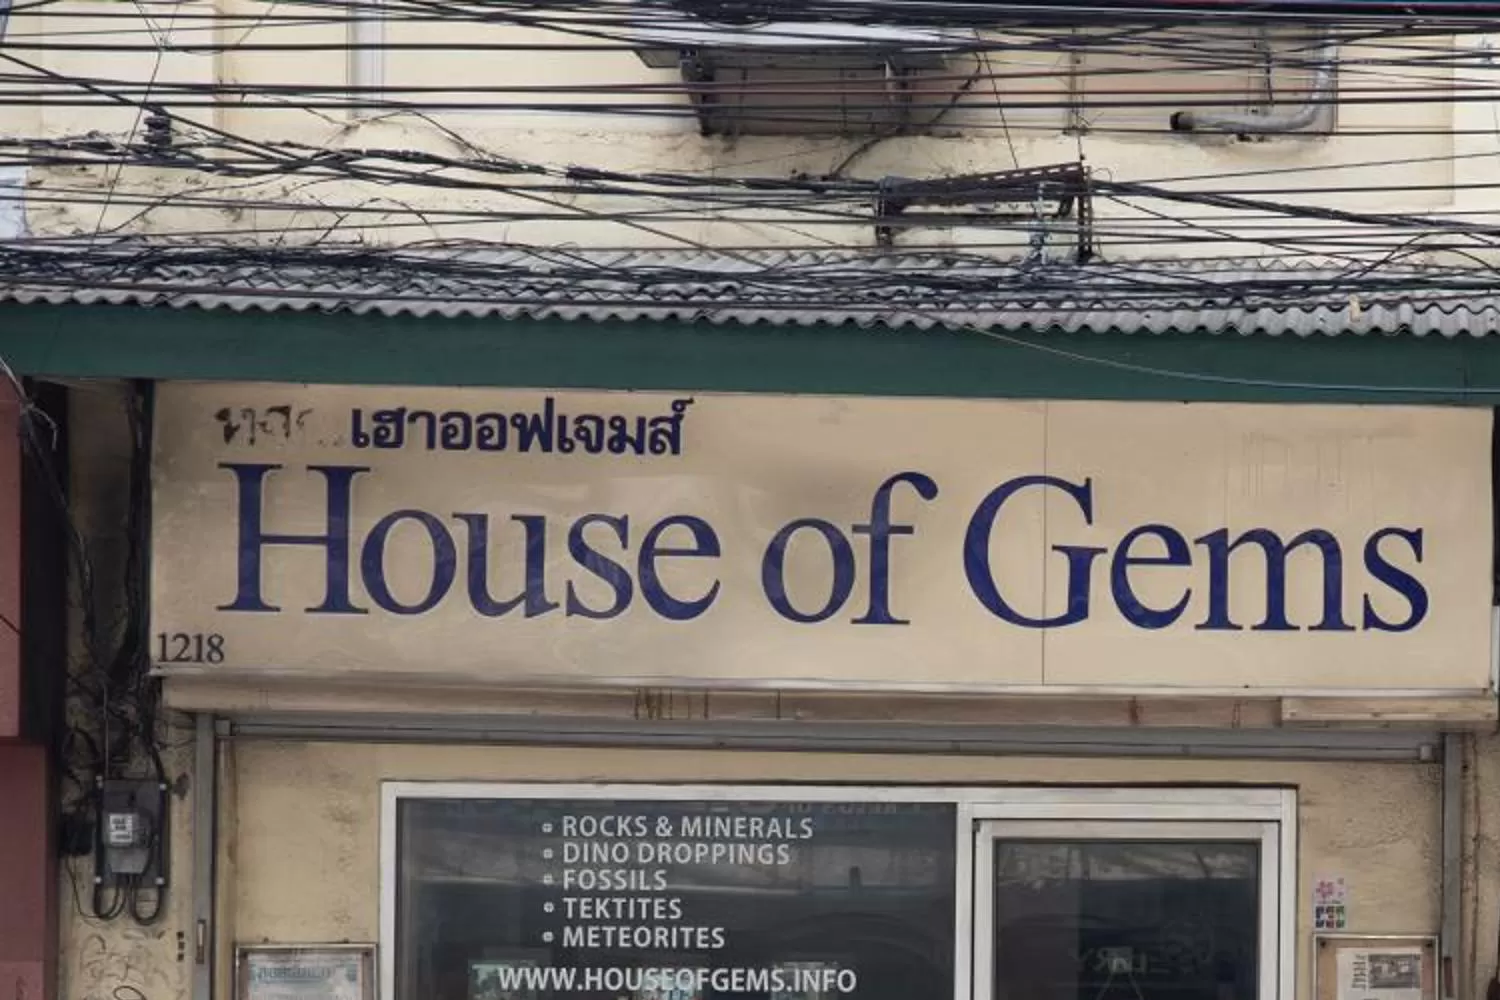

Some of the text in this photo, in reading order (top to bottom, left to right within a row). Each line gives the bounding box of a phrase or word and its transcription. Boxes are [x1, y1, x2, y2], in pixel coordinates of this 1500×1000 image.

[351, 396, 695, 456] เฮาออฟเจมส์
[216, 462, 1429, 633] House of Gems
[157, 632, 225, 664] 1218
[562, 815, 814, 839] ROCKS & MINERALS
[562, 842, 791, 865] DINO DROPPINGS
[562, 869, 668, 891] FOSSILS
[562, 897, 683, 920] TEKTITES
[562, 926, 726, 949] METEORITES
[499, 967, 858, 993] WWW.HOUSEOFGEMS.INFO
